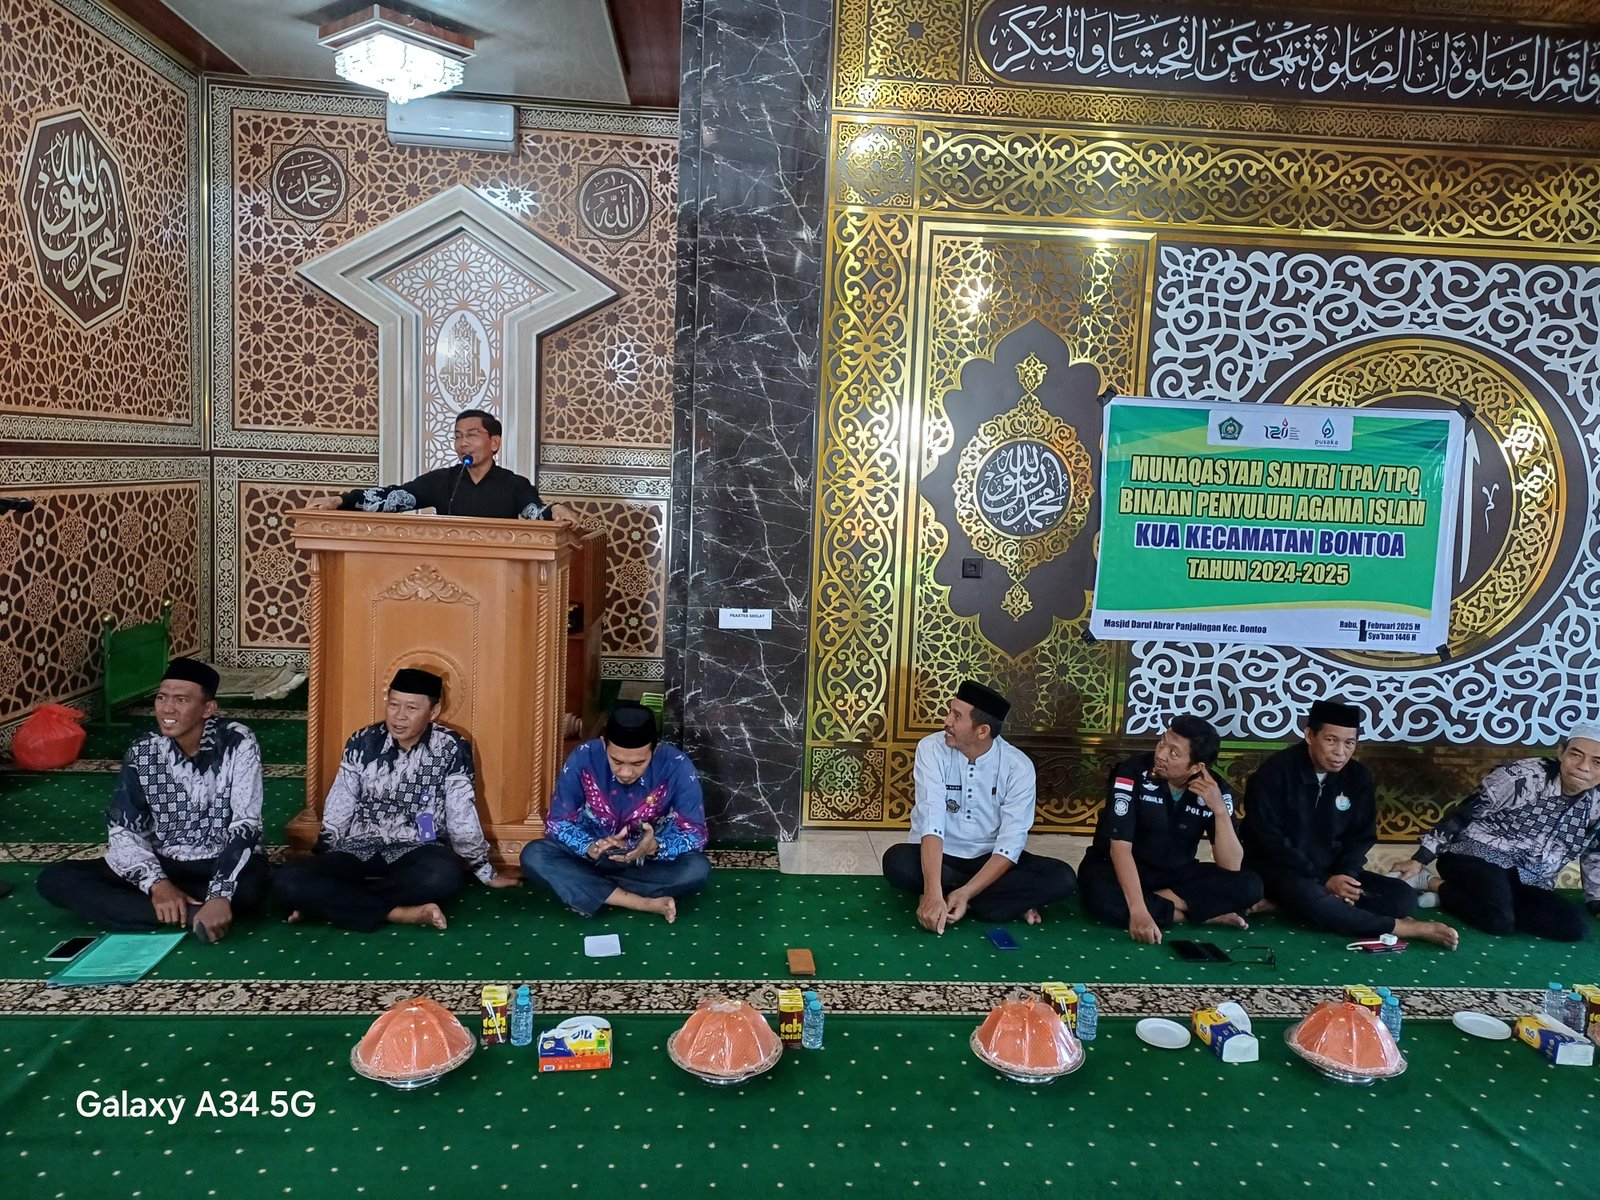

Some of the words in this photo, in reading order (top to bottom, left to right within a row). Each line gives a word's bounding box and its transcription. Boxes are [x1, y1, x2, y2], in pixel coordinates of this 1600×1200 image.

[1314, 438, 1339, 446] pusaka
[1130, 455, 1265, 486] MUNAQASYAH
[1266, 461, 1338, 490] SANTRI
[1339, 464, 1422, 495] TPA/TPQ
[1119, 488, 1194, 516] BINAAN
[1195, 491, 1294, 520] PENYULUH
[1296, 496, 1366, 524] AGAMA
[1367, 498, 1427, 526] ISLAM
[1135, 522, 1181, 549] KUA
[1185, 524, 1316, 554] KECAMATAN
[1318, 530, 1406, 558] BONTOA
[1187, 558, 1248, 581] TAHUN
[1249, 560, 1350, 585] 2024-2025
[1103, 619, 1130, 629] Masjid
[1131, 620, 1152, 629] Darul
[1153, 621, 1175, 630] Abrar
[1175, 622, 1221, 632] Panjalingan
[1222, 624, 1239, 633] Kec.
[1240, 625, 1267, 634] Bontoa
[1367, 622, 1396, 630] Februari
[1396, 623, 1413, 631] 2025
[1414, 623, 1420, 631] M
[1367, 632, 1394, 641] Sya'ban
[1395, 633, 1410, 641] 1446
[1185, 805, 1200, 816] POL
[780, 1018, 802, 1033] teh
